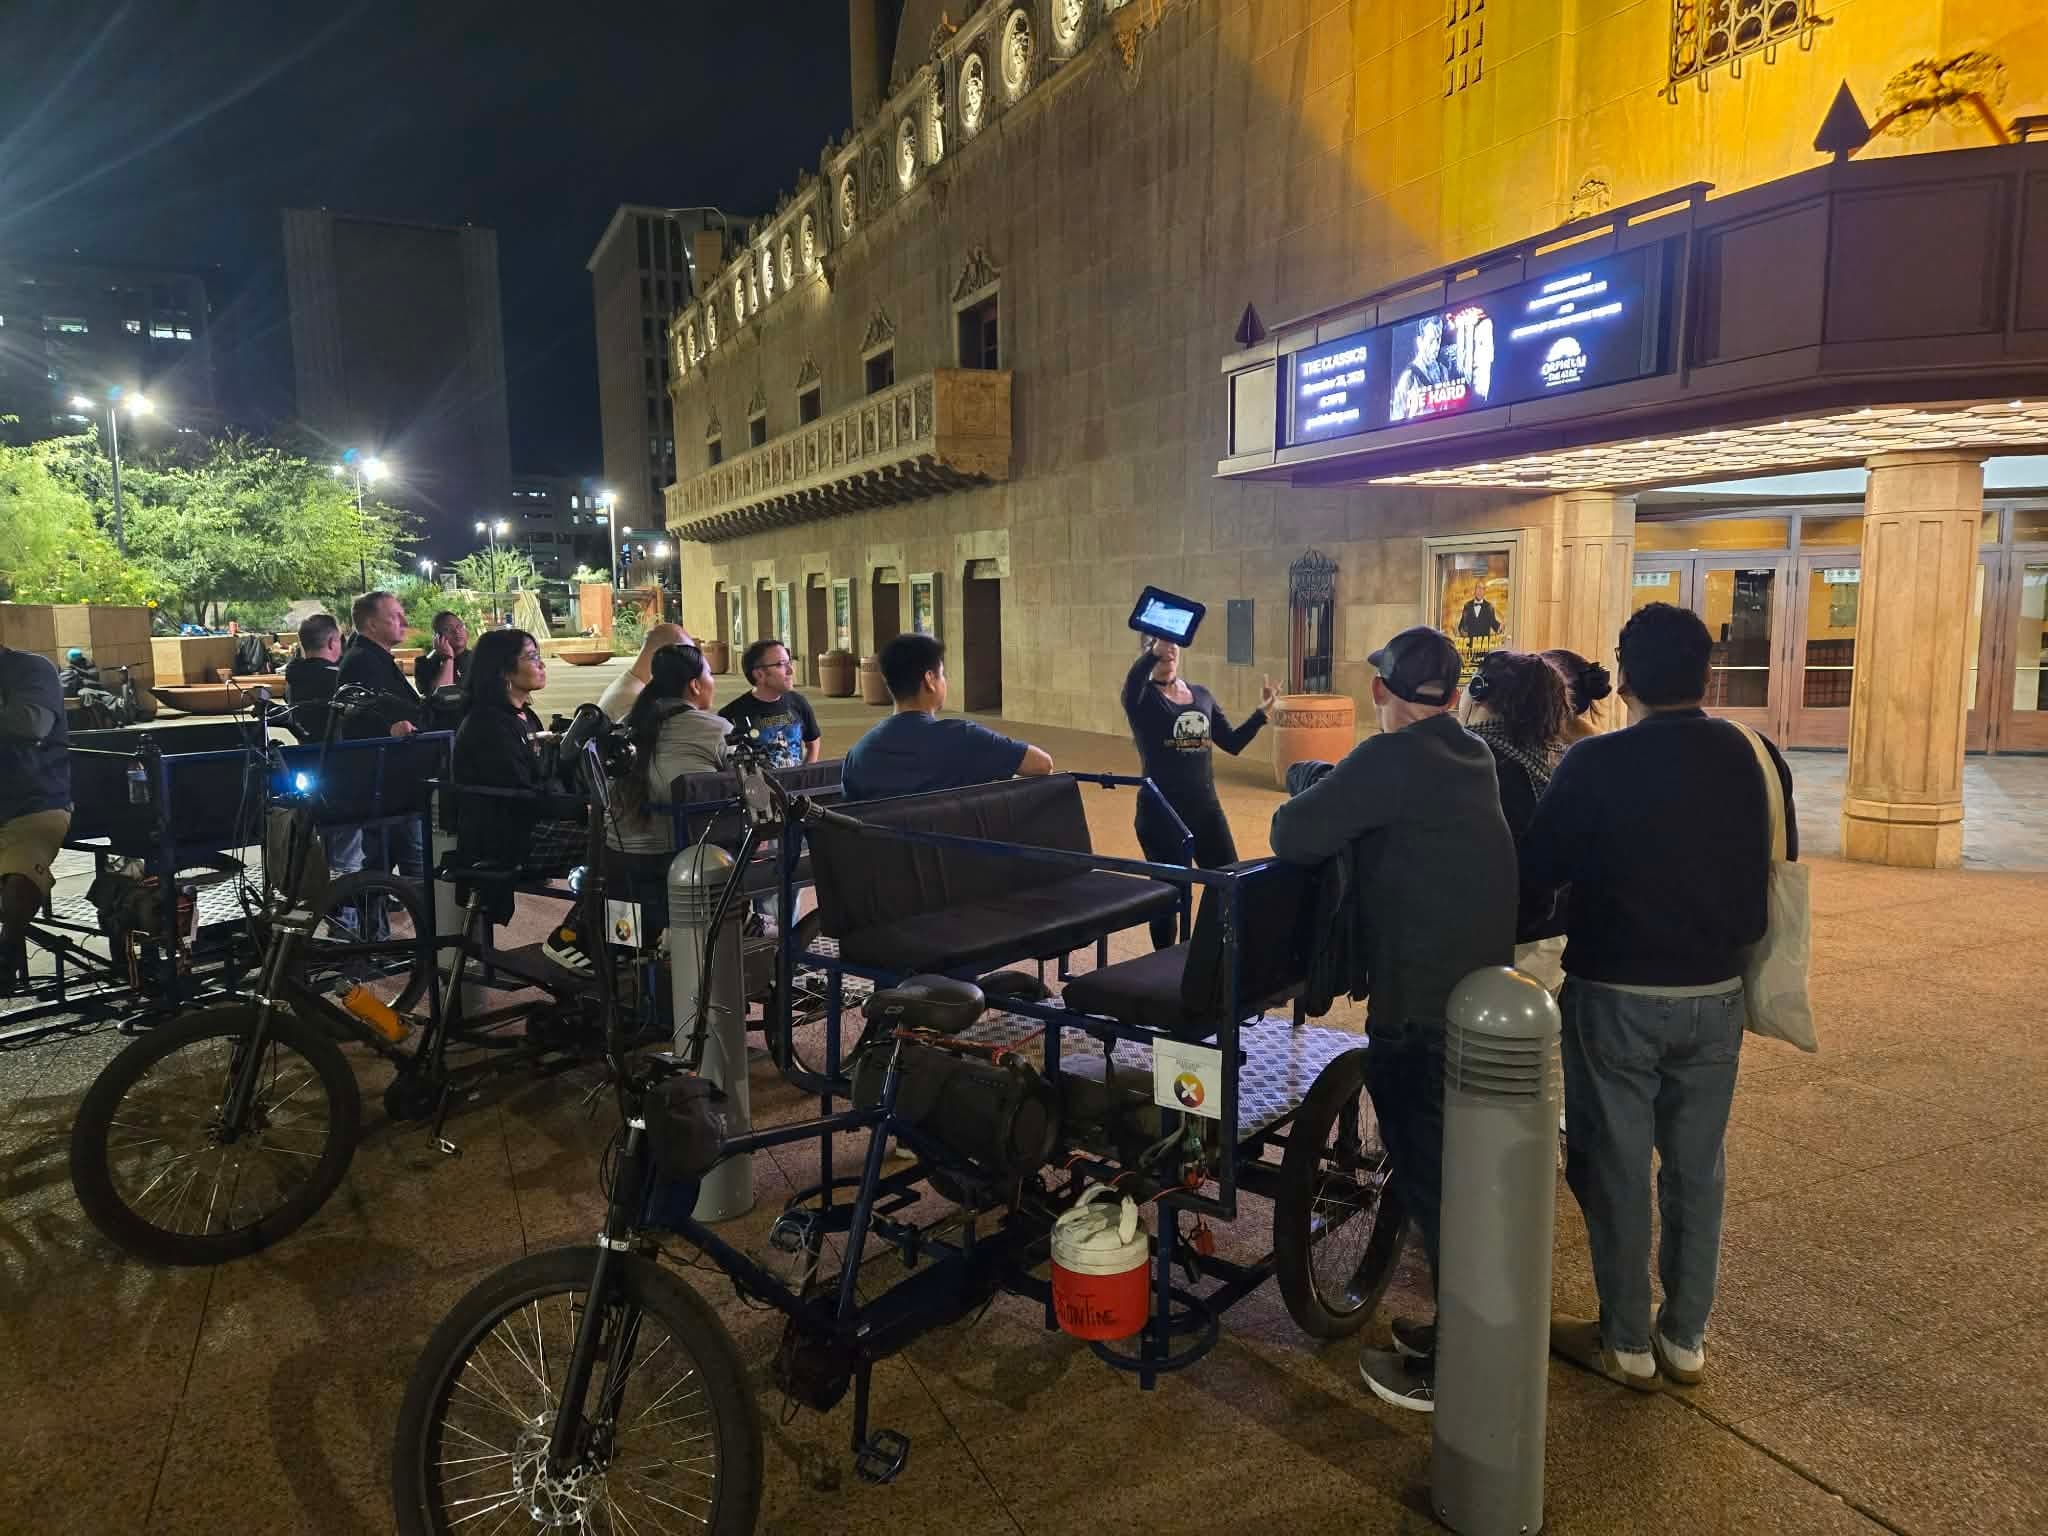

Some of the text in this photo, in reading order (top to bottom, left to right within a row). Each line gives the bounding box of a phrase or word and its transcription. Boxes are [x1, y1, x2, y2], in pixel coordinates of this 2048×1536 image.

[1303, 347, 1367, 376] THE CLASSICS
[1541, 355, 1587, 376] ORPHEUM
[1429, 385, 1466, 404] HARD
